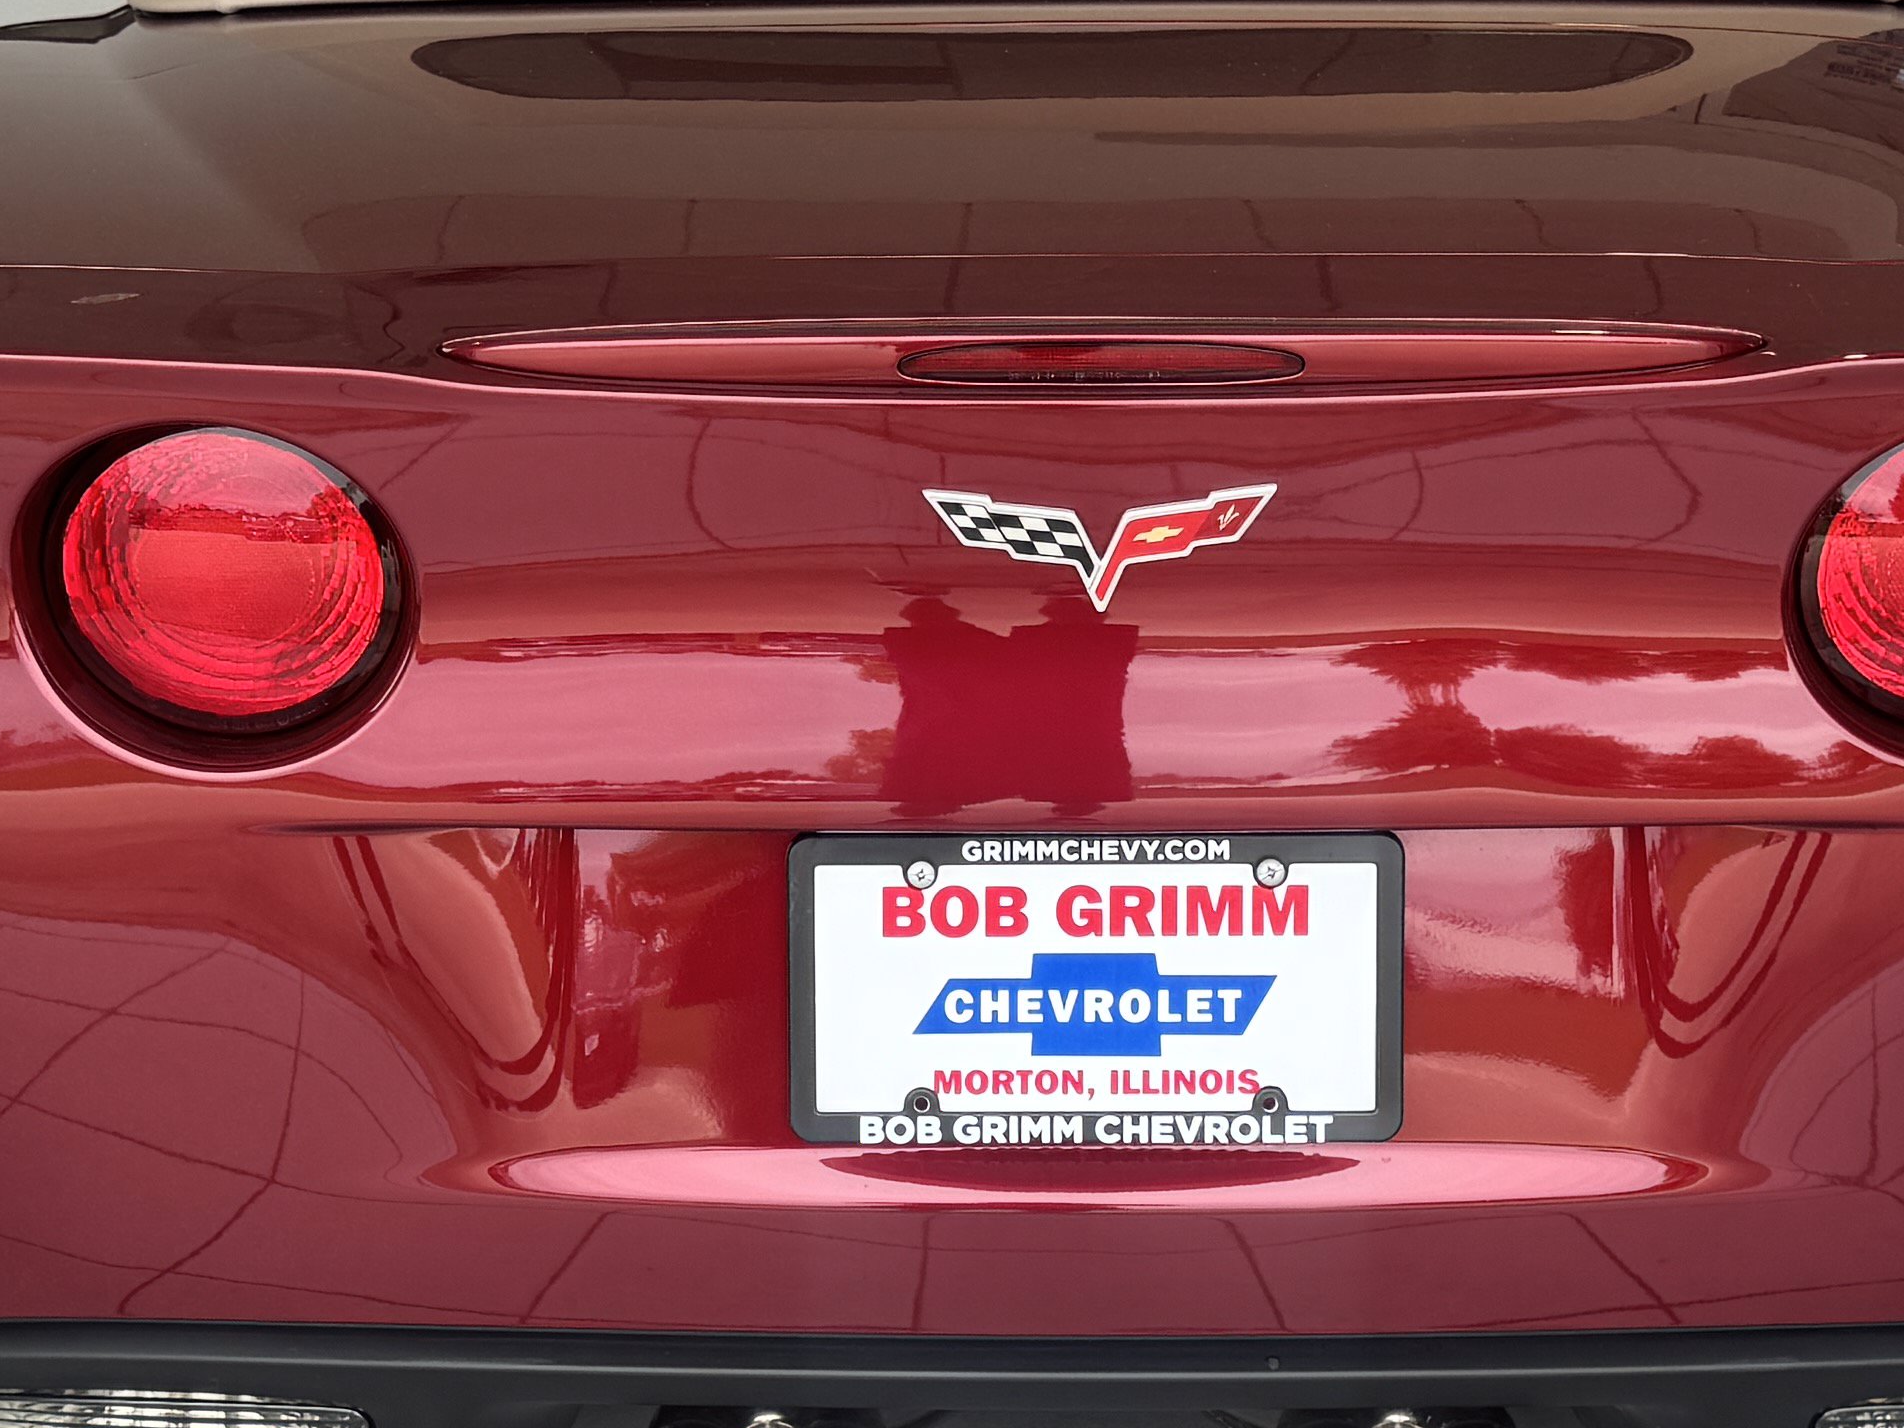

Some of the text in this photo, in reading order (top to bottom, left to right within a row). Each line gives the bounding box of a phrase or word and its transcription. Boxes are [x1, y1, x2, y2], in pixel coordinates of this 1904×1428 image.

[961, 839, 1231, 862] GRIMMCHEVY.COM
[882, 885, 1309, 938] BOB GRIMM
[943, 987, 1244, 1024] CHEVROLET
[933, 1069, 1260, 1101] MORTON, ILLINOIS
[859, 1114, 1334, 1145] BOB GRIMM CHEVROLET
